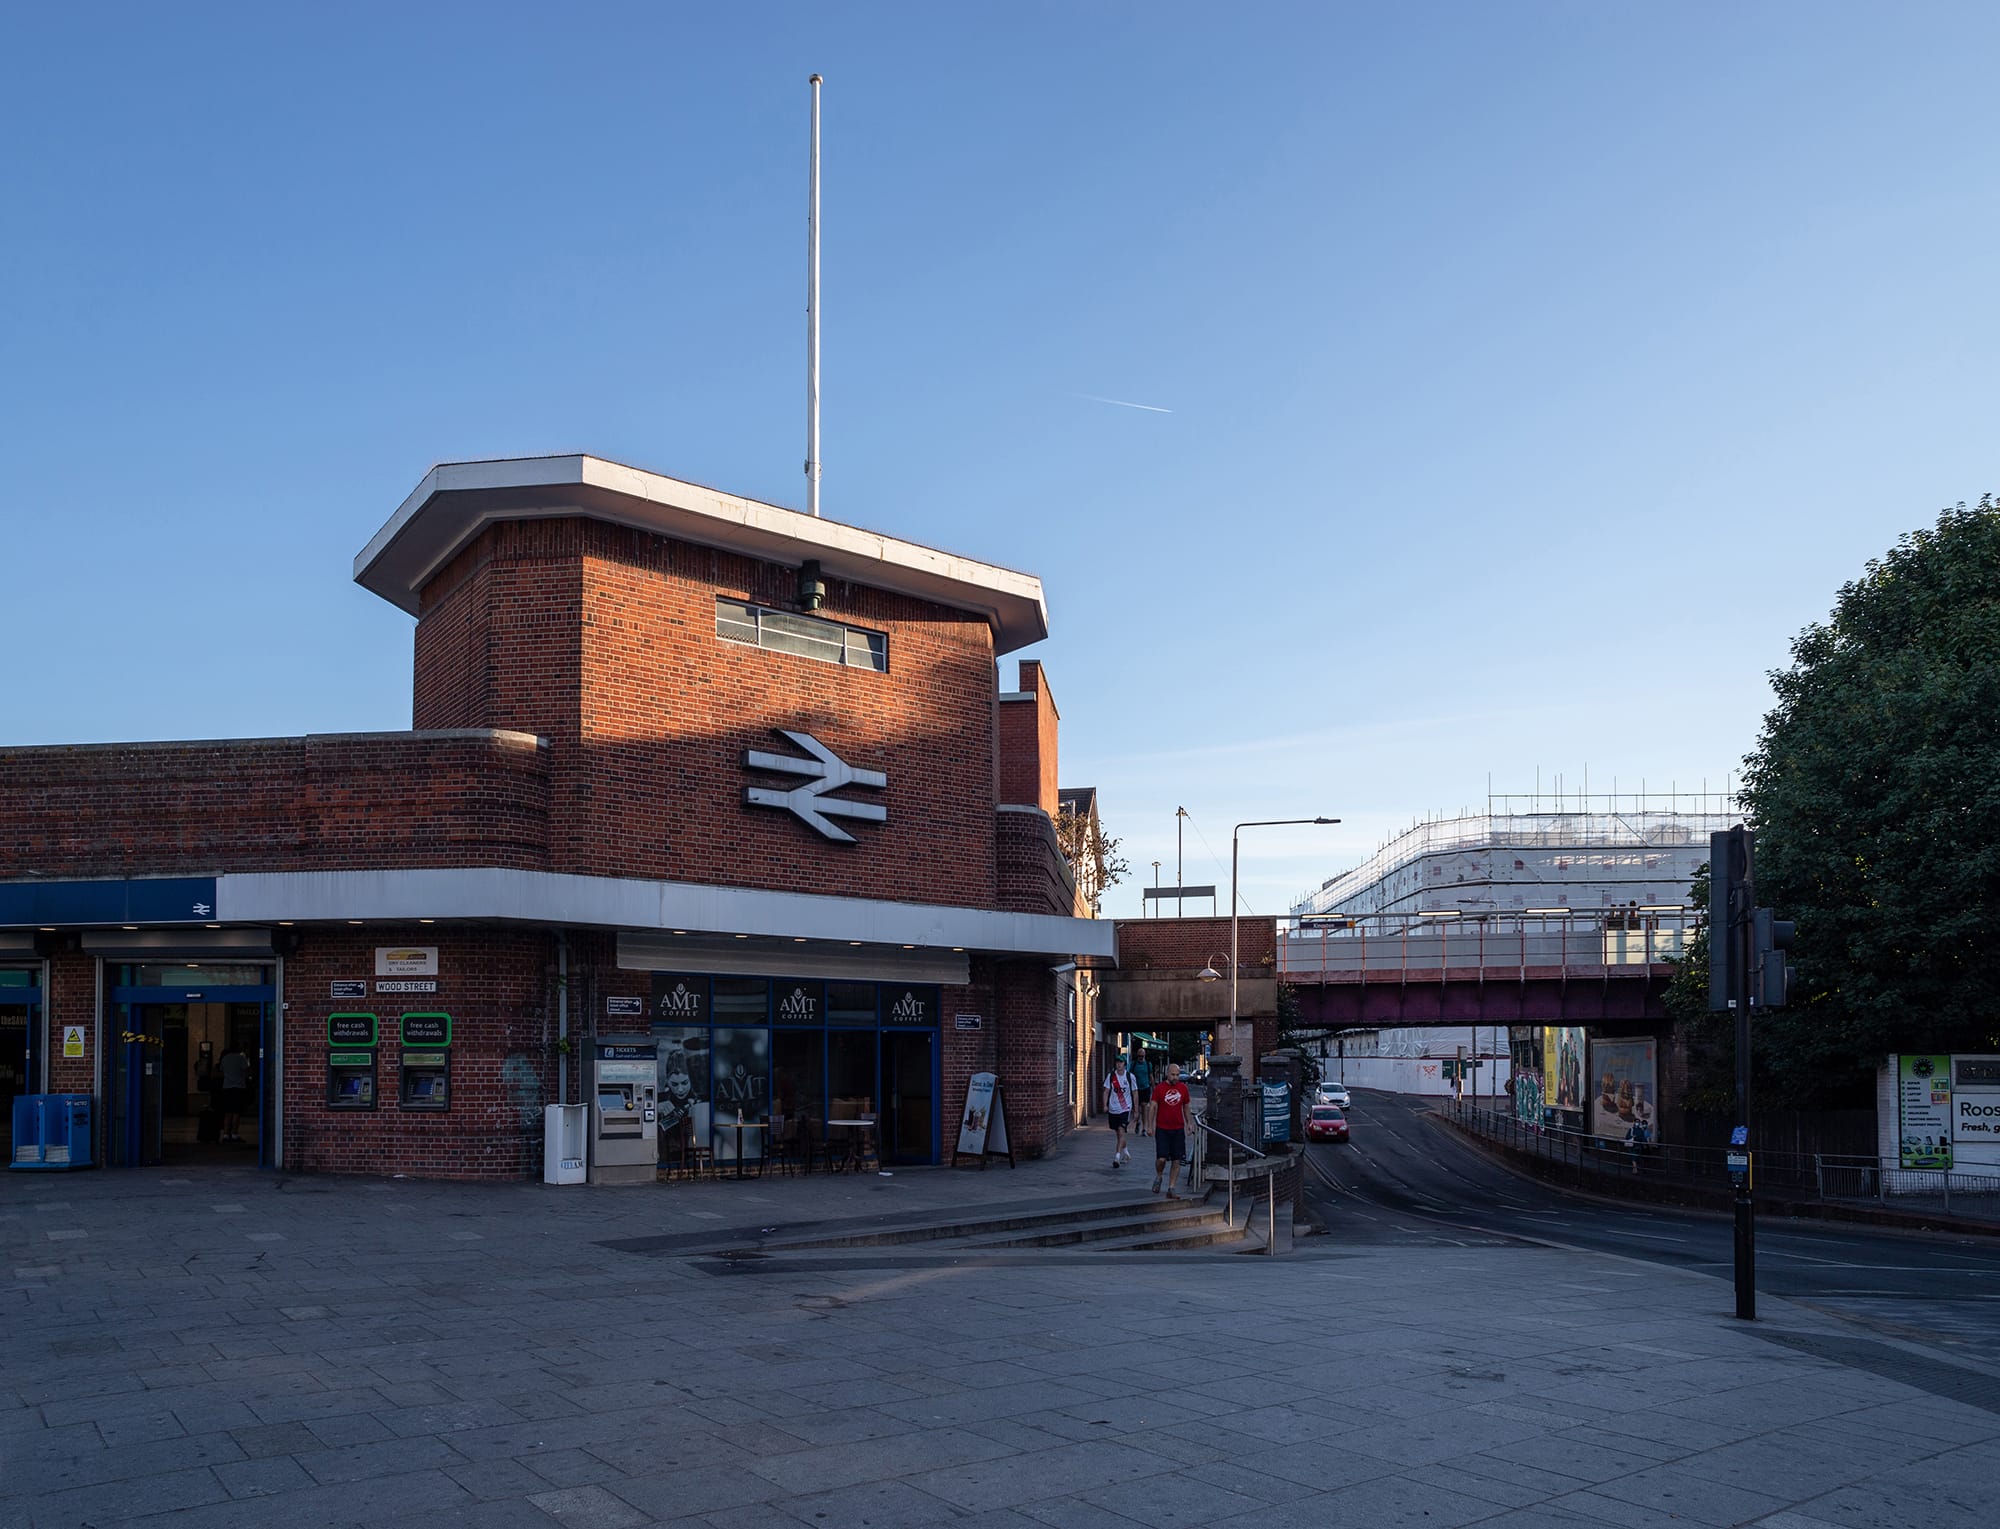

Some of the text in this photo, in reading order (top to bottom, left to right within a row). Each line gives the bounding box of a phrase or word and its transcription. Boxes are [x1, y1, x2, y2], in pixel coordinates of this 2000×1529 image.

[378, 983, 434, 991] WOOD STREET
[660, 991, 701, 1010] AMT
[780, 995, 817, 1014] AMT
[892, 999, 925, 1017] AMT
[716, 1075, 767, 1101] AMT
[1961, 1122, 1991, 1132] Fresh,
